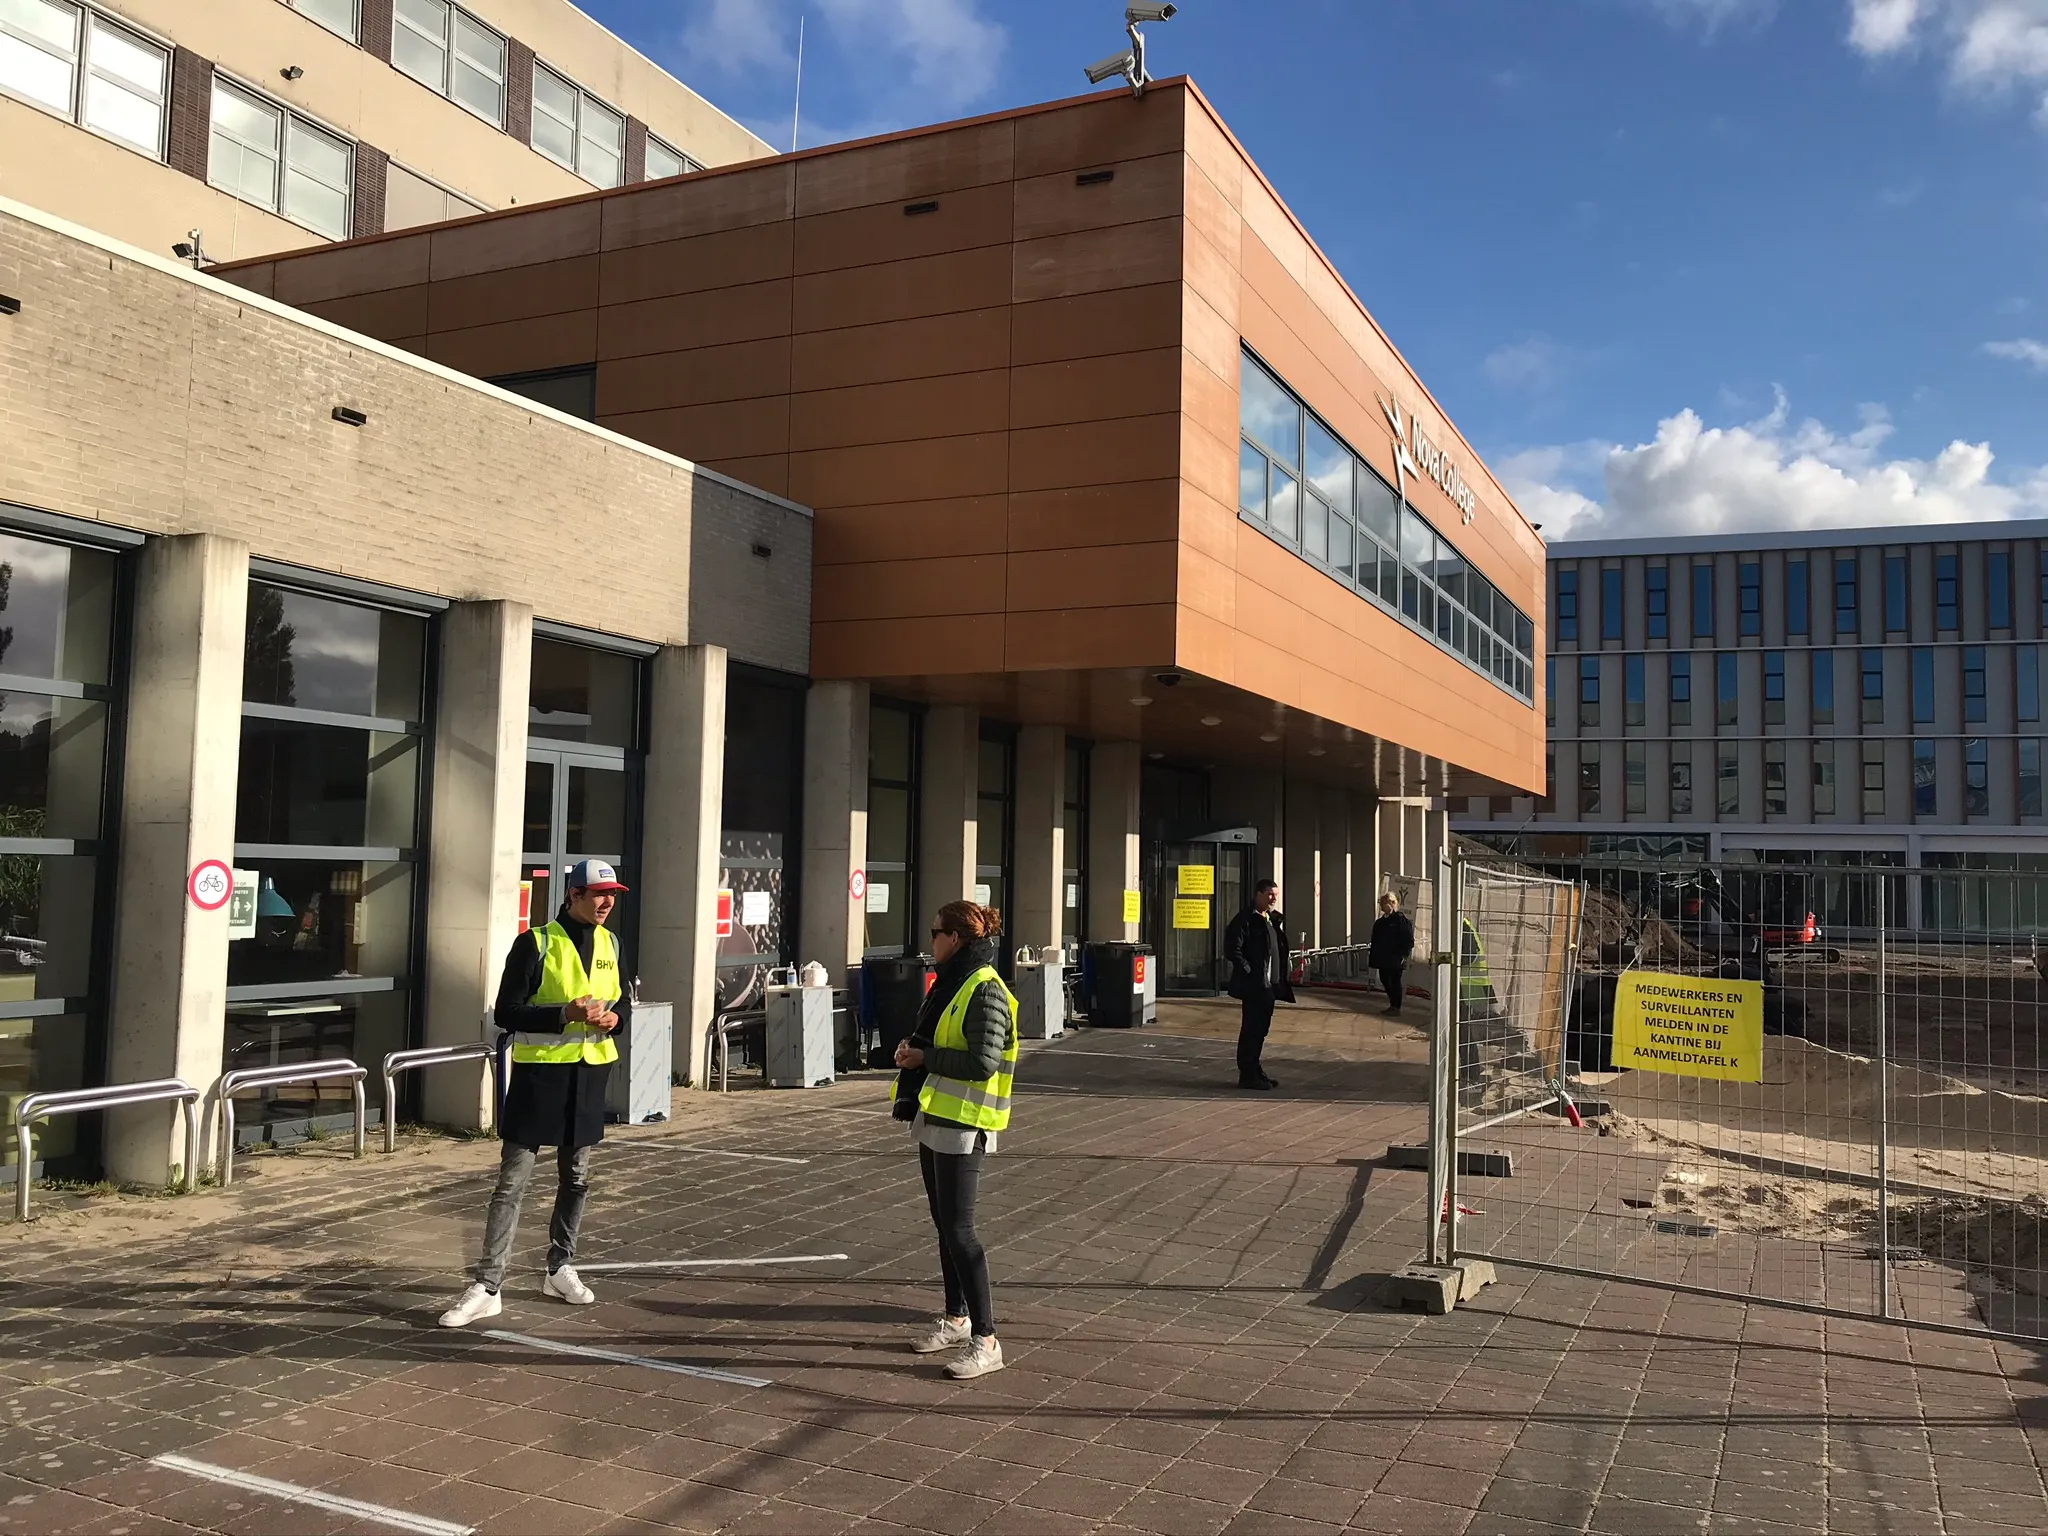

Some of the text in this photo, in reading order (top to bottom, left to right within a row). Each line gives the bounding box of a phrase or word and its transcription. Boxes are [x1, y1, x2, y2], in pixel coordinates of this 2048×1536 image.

[1412, 414, 1475, 525] Nova College
[596, 959, 614, 970] BHV
[1635, 983, 1742, 1003] MEDEWERKERS EN
[1641, 1000, 1734, 1019] SURVEILLANTEN
[1645, 1017, 1728, 1035] MELDEN IN DE
[1650, 1033, 1721, 1050] KANTINE BIJ
[1633, 1047, 1738, 1067] AANMELDTAFEL K
